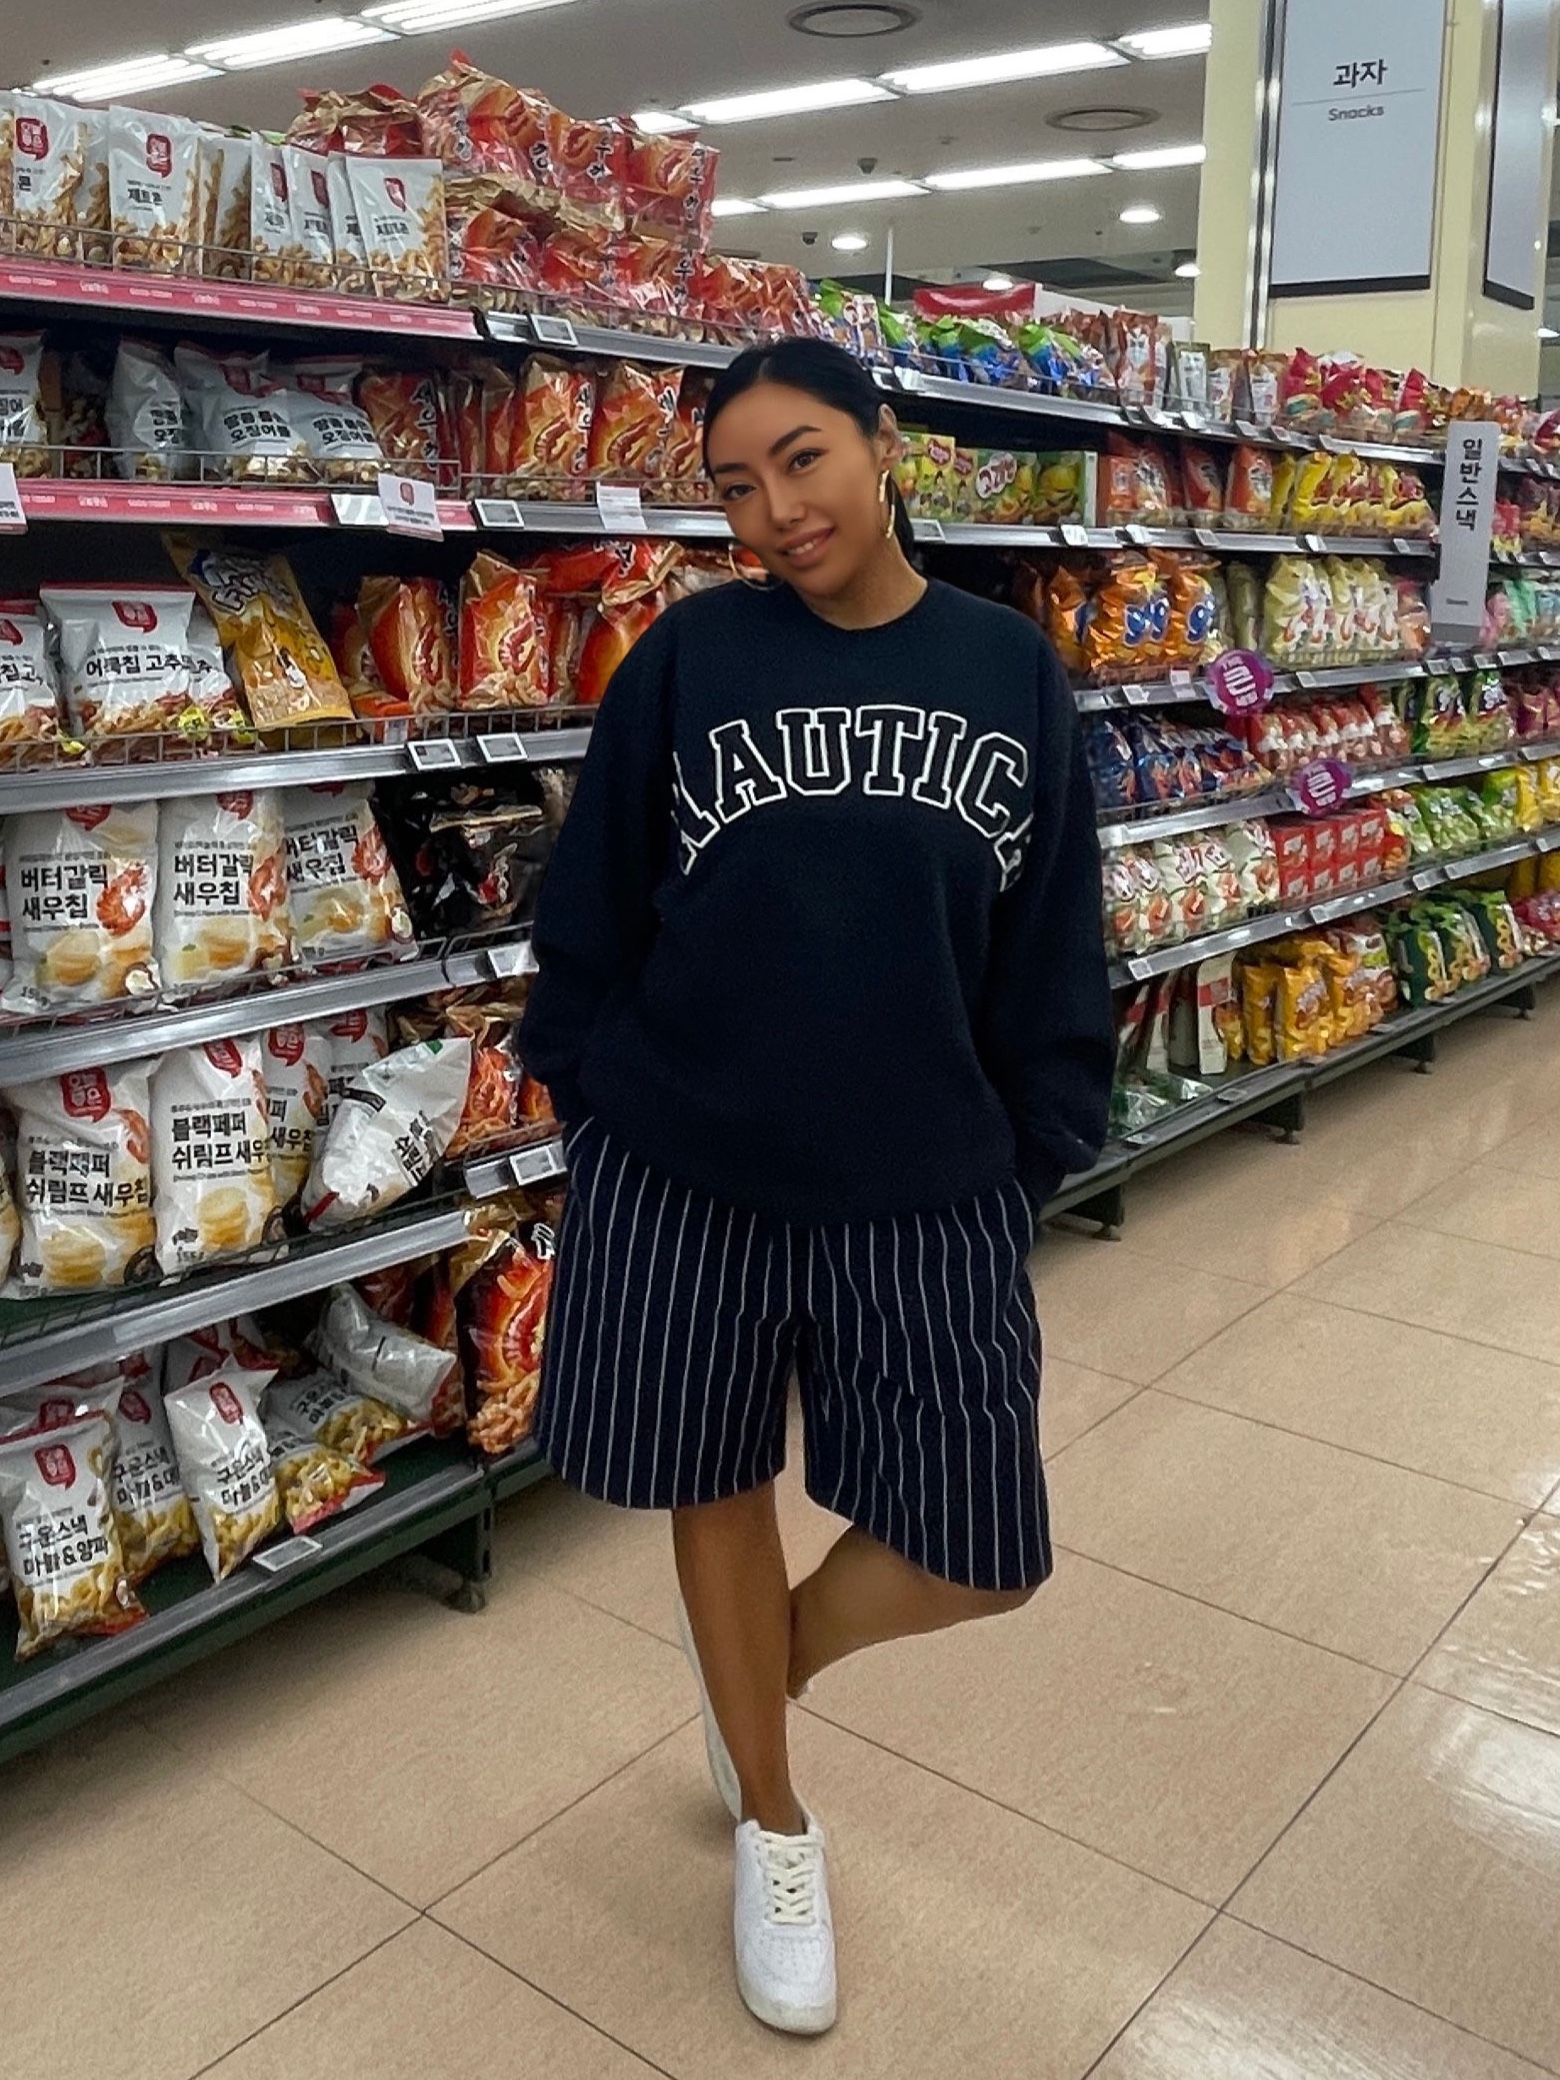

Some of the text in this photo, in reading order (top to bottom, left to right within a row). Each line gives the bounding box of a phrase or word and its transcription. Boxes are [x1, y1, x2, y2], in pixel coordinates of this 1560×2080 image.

[1333, 59, 1388, 88] 과자
[1328, 104, 1385, 121] Snacks
[1456, 438, 1484, 531] 일반스낵
[20, 864, 109, 892] 버터갈릭
[174, 853, 253, 878] 버터갈릭
[22, 893, 88, 921] 새우칩
[174, 880, 241, 906] 새우칩
[172, 1110, 247, 1143] 블랙페퍼
[27, 1149, 111, 1178] 블랙페퍼
